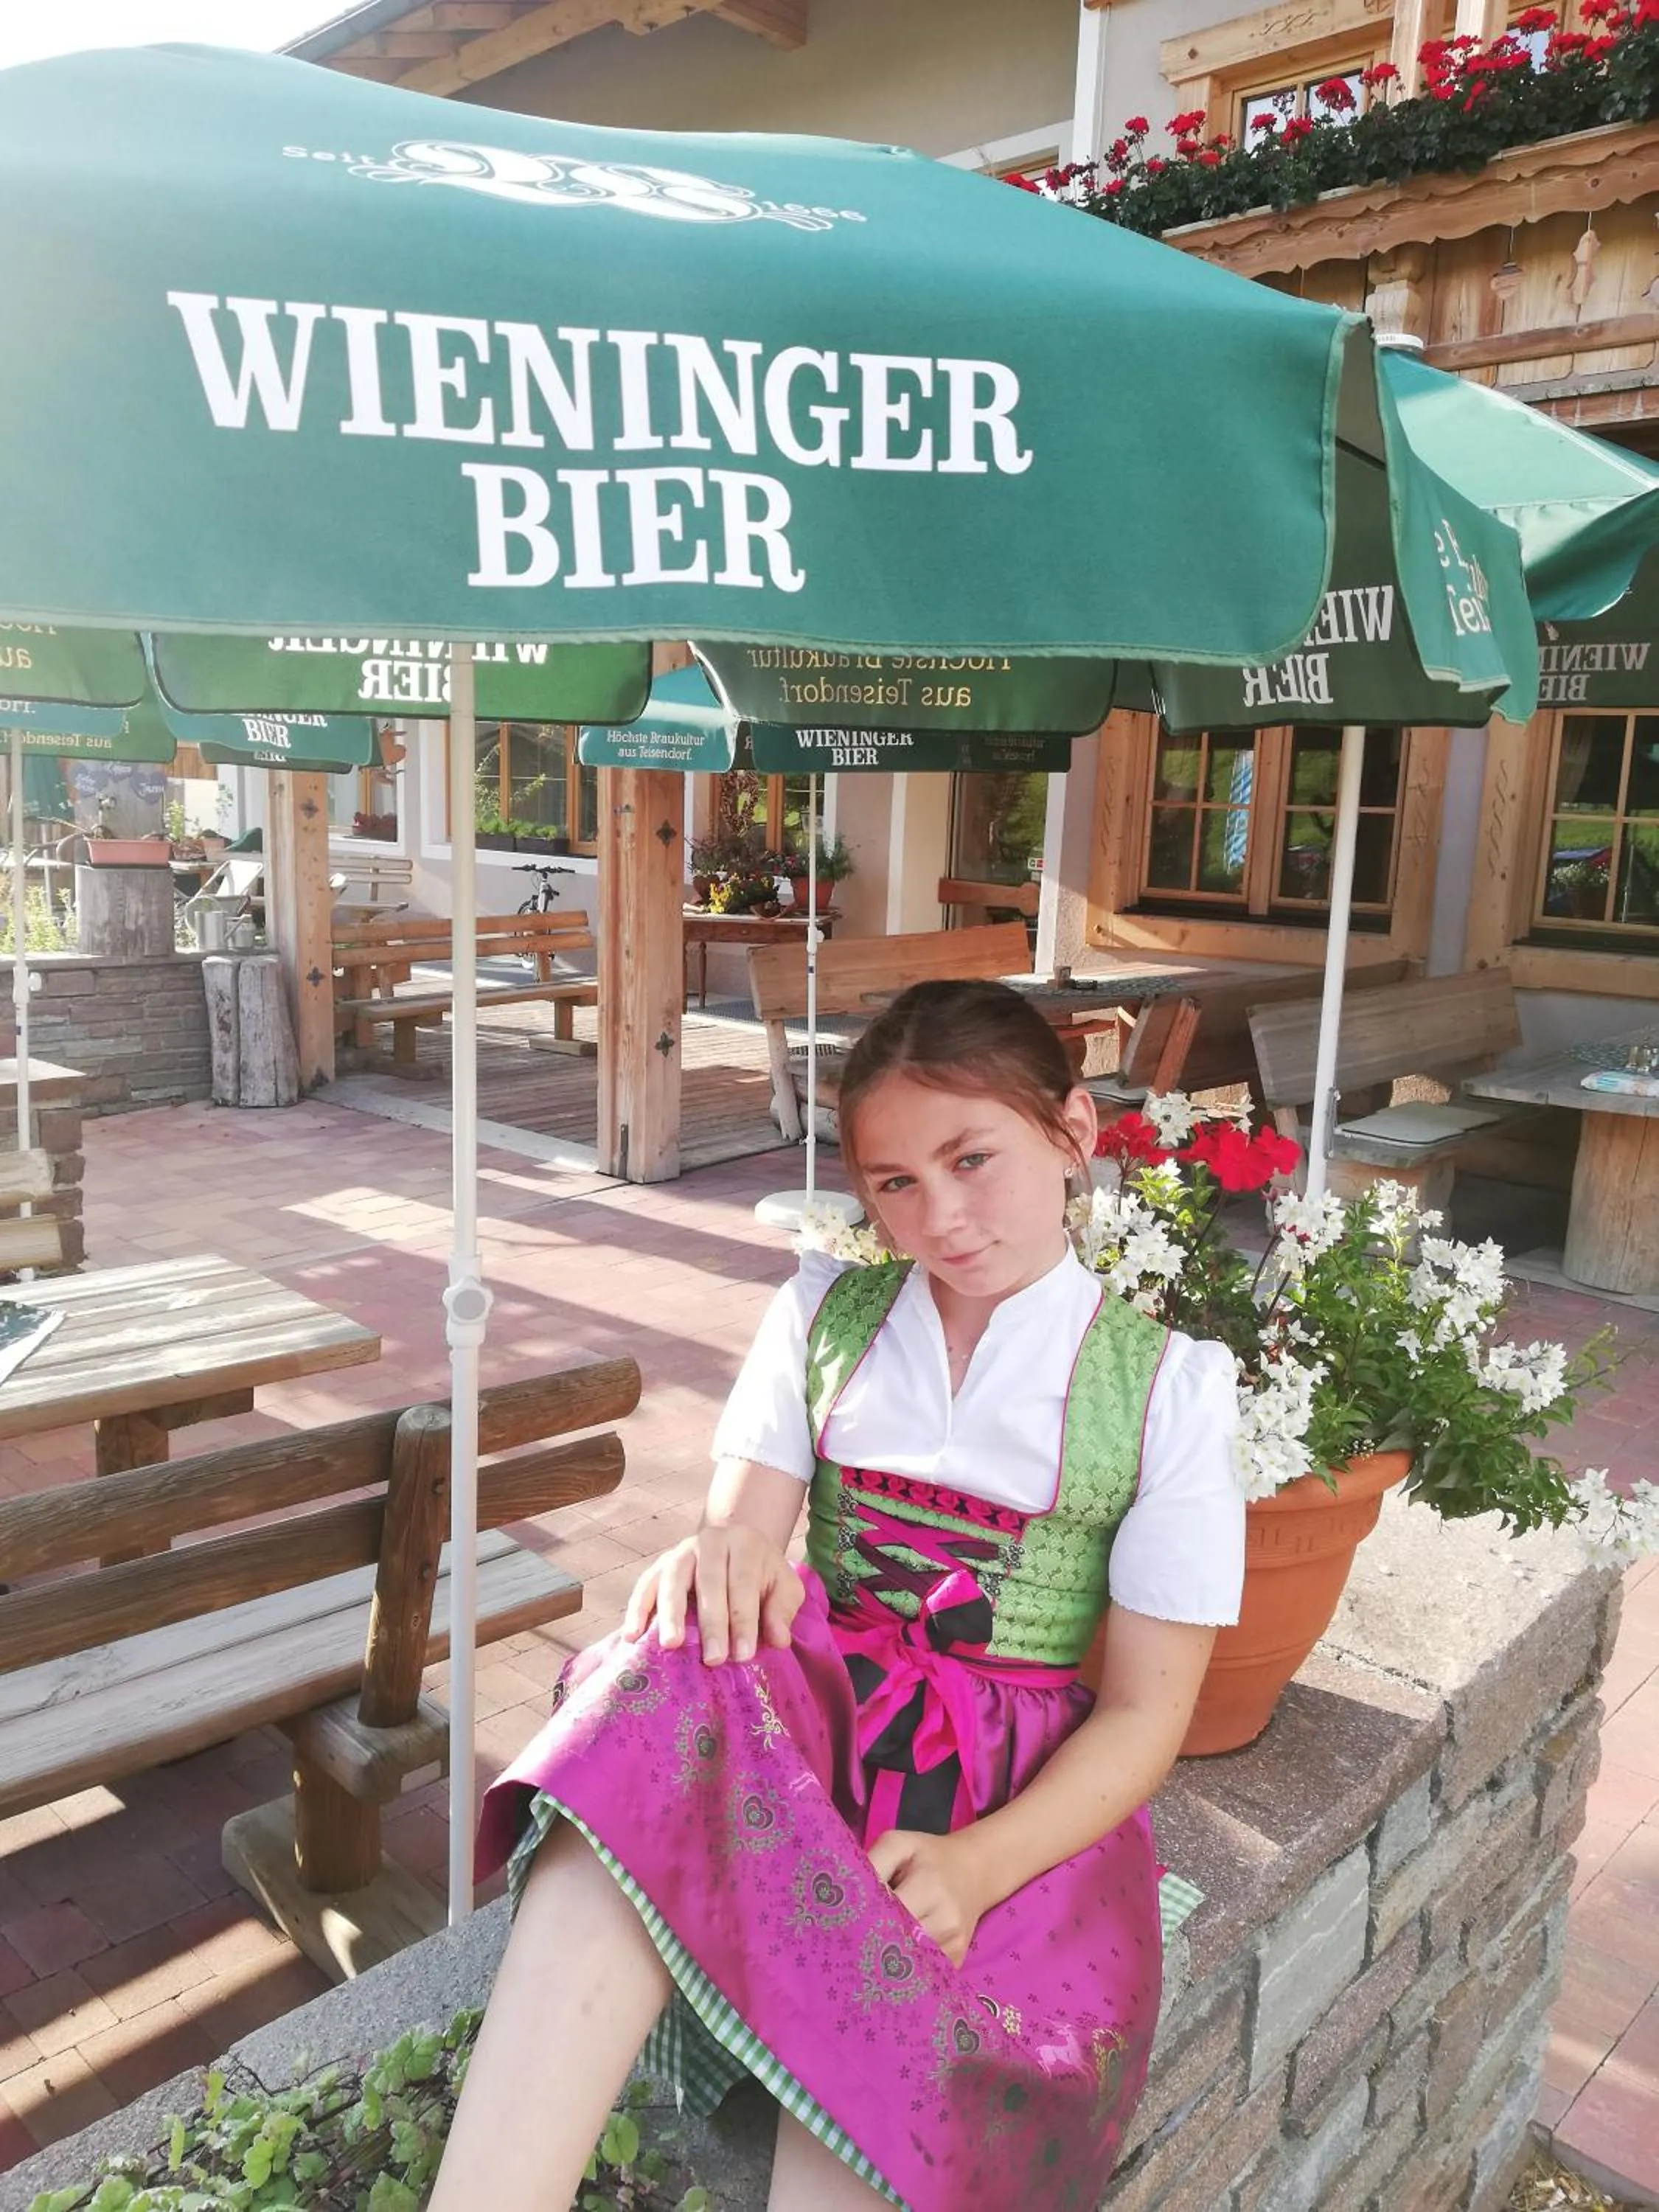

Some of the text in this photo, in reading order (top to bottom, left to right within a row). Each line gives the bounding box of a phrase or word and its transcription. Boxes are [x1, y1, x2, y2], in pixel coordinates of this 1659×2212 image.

[167, 291, 1032, 475] WIENINGER
[462, 462, 806, 593] BIER
[242, 718, 292, 749] BIER
[607, 729, 706, 747] Höchste Braukultur
[796, 729, 915, 748] WIENINGER
[617, 745, 693, 761] aus Teisendorf.
[832, 747, 880, 766] BIER
